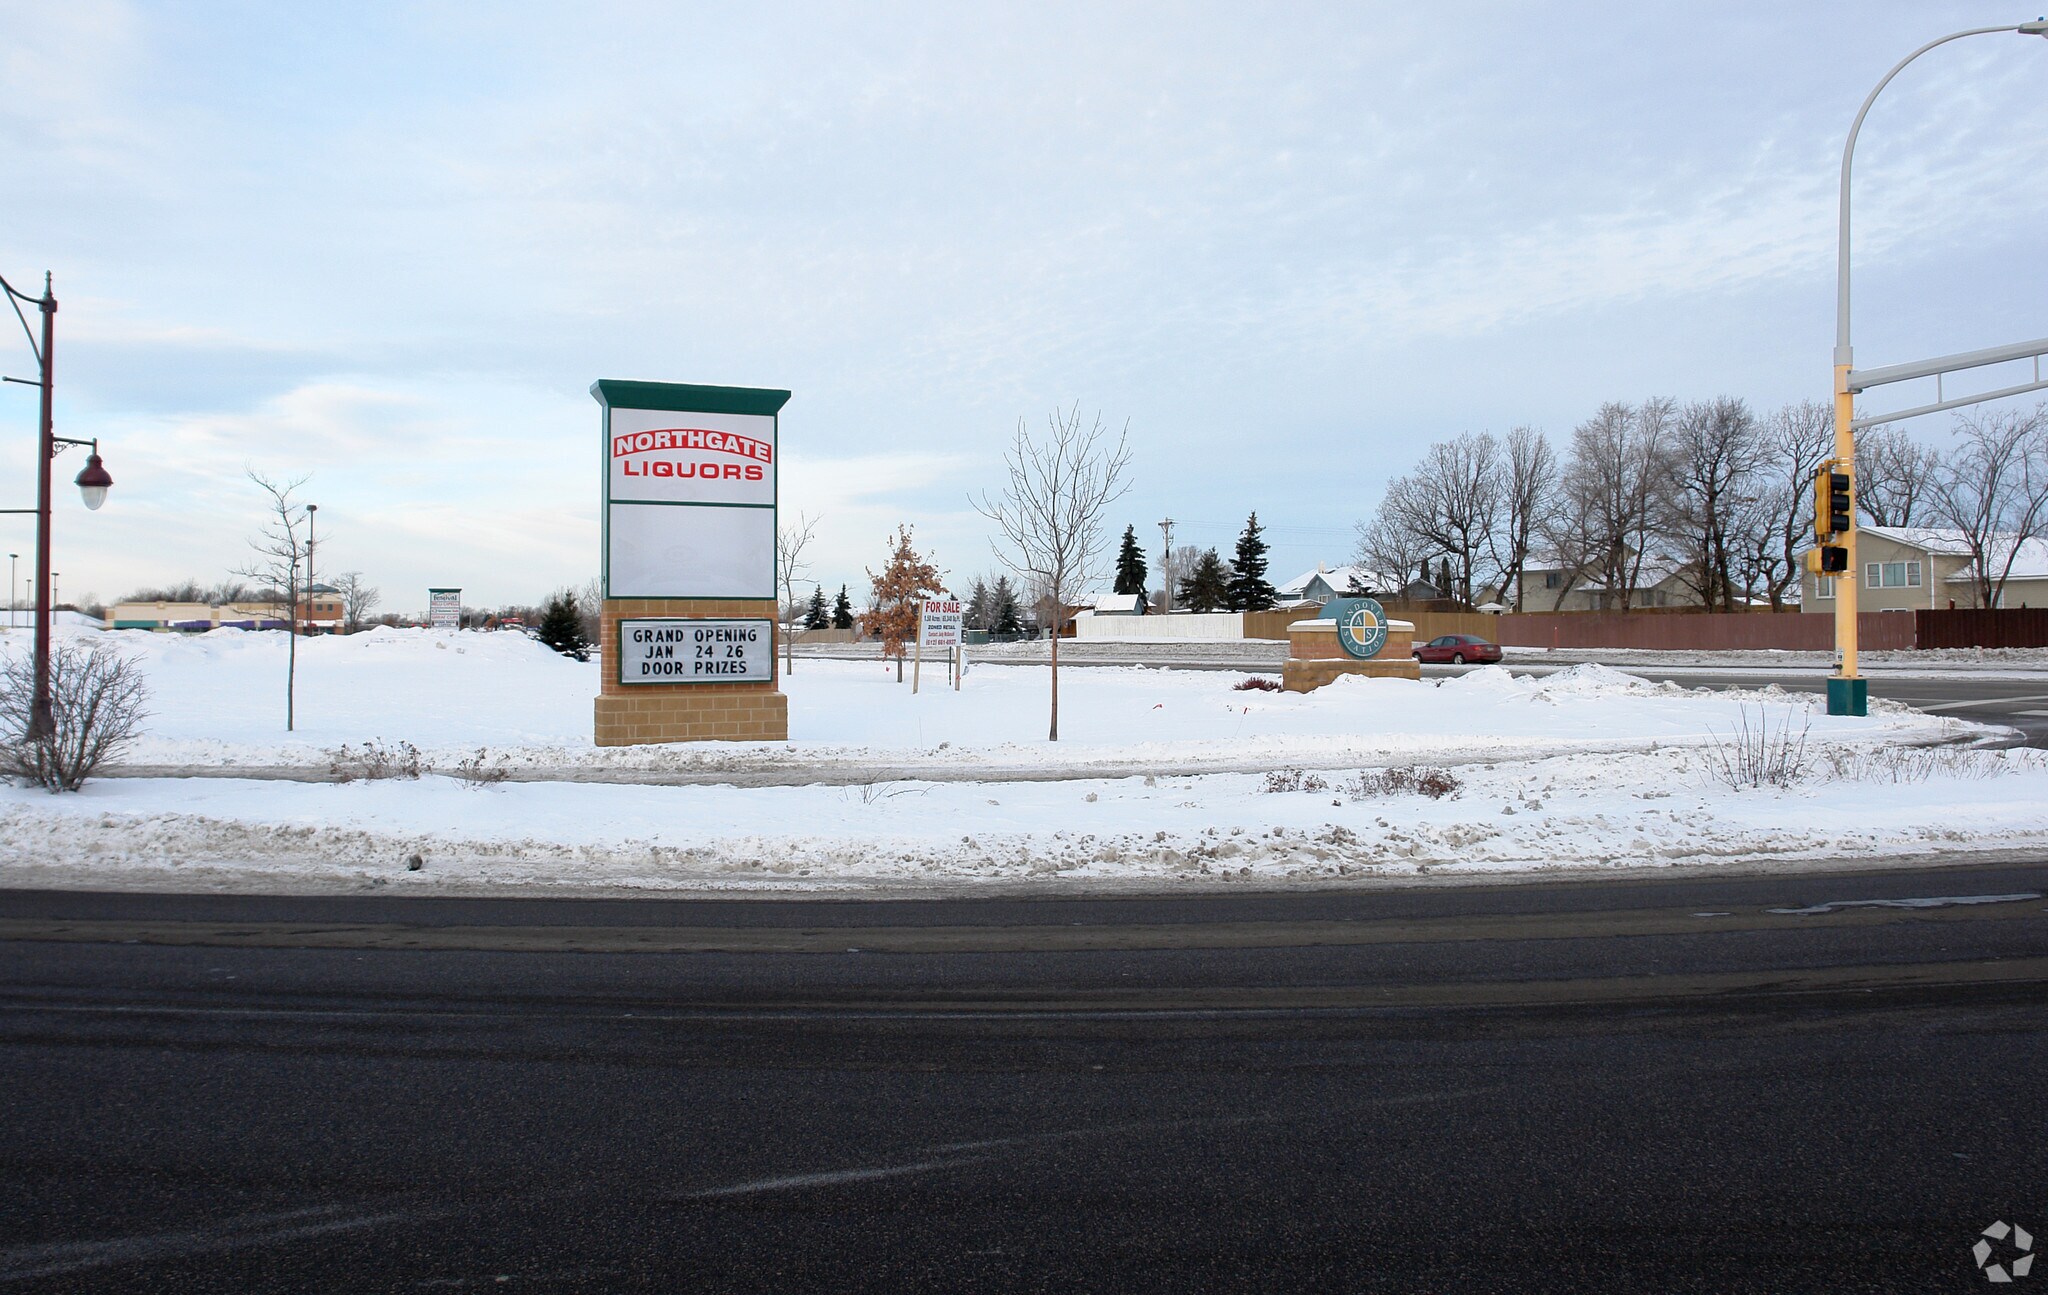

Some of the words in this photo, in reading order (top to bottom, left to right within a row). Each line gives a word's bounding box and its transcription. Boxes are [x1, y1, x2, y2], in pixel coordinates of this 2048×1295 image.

[615, 430, 770, 462] NORTHGATE
[623, 460, 764, 481] LIQUORS
[925, 601, 940, 613] FOR
[942, 601, 960, 613] SALE
[1344, 601, 1384, 625] ANDOVER
[1355, 615, 1362, 625] A
[633, 629, 684, 643] GRAND
[694, 629, 757, 642] OPENING
[1366, 629, 1372, 639] S
[1343, 630, 1384, 653] STATION
[645, 645, 673, 658] JAN
[695, 645, 714, 658] 24
[726, 645, 744, 658] 26
[642, 661, 683, 675] DOOR
[694, 661, 747, 674] PRIZES
